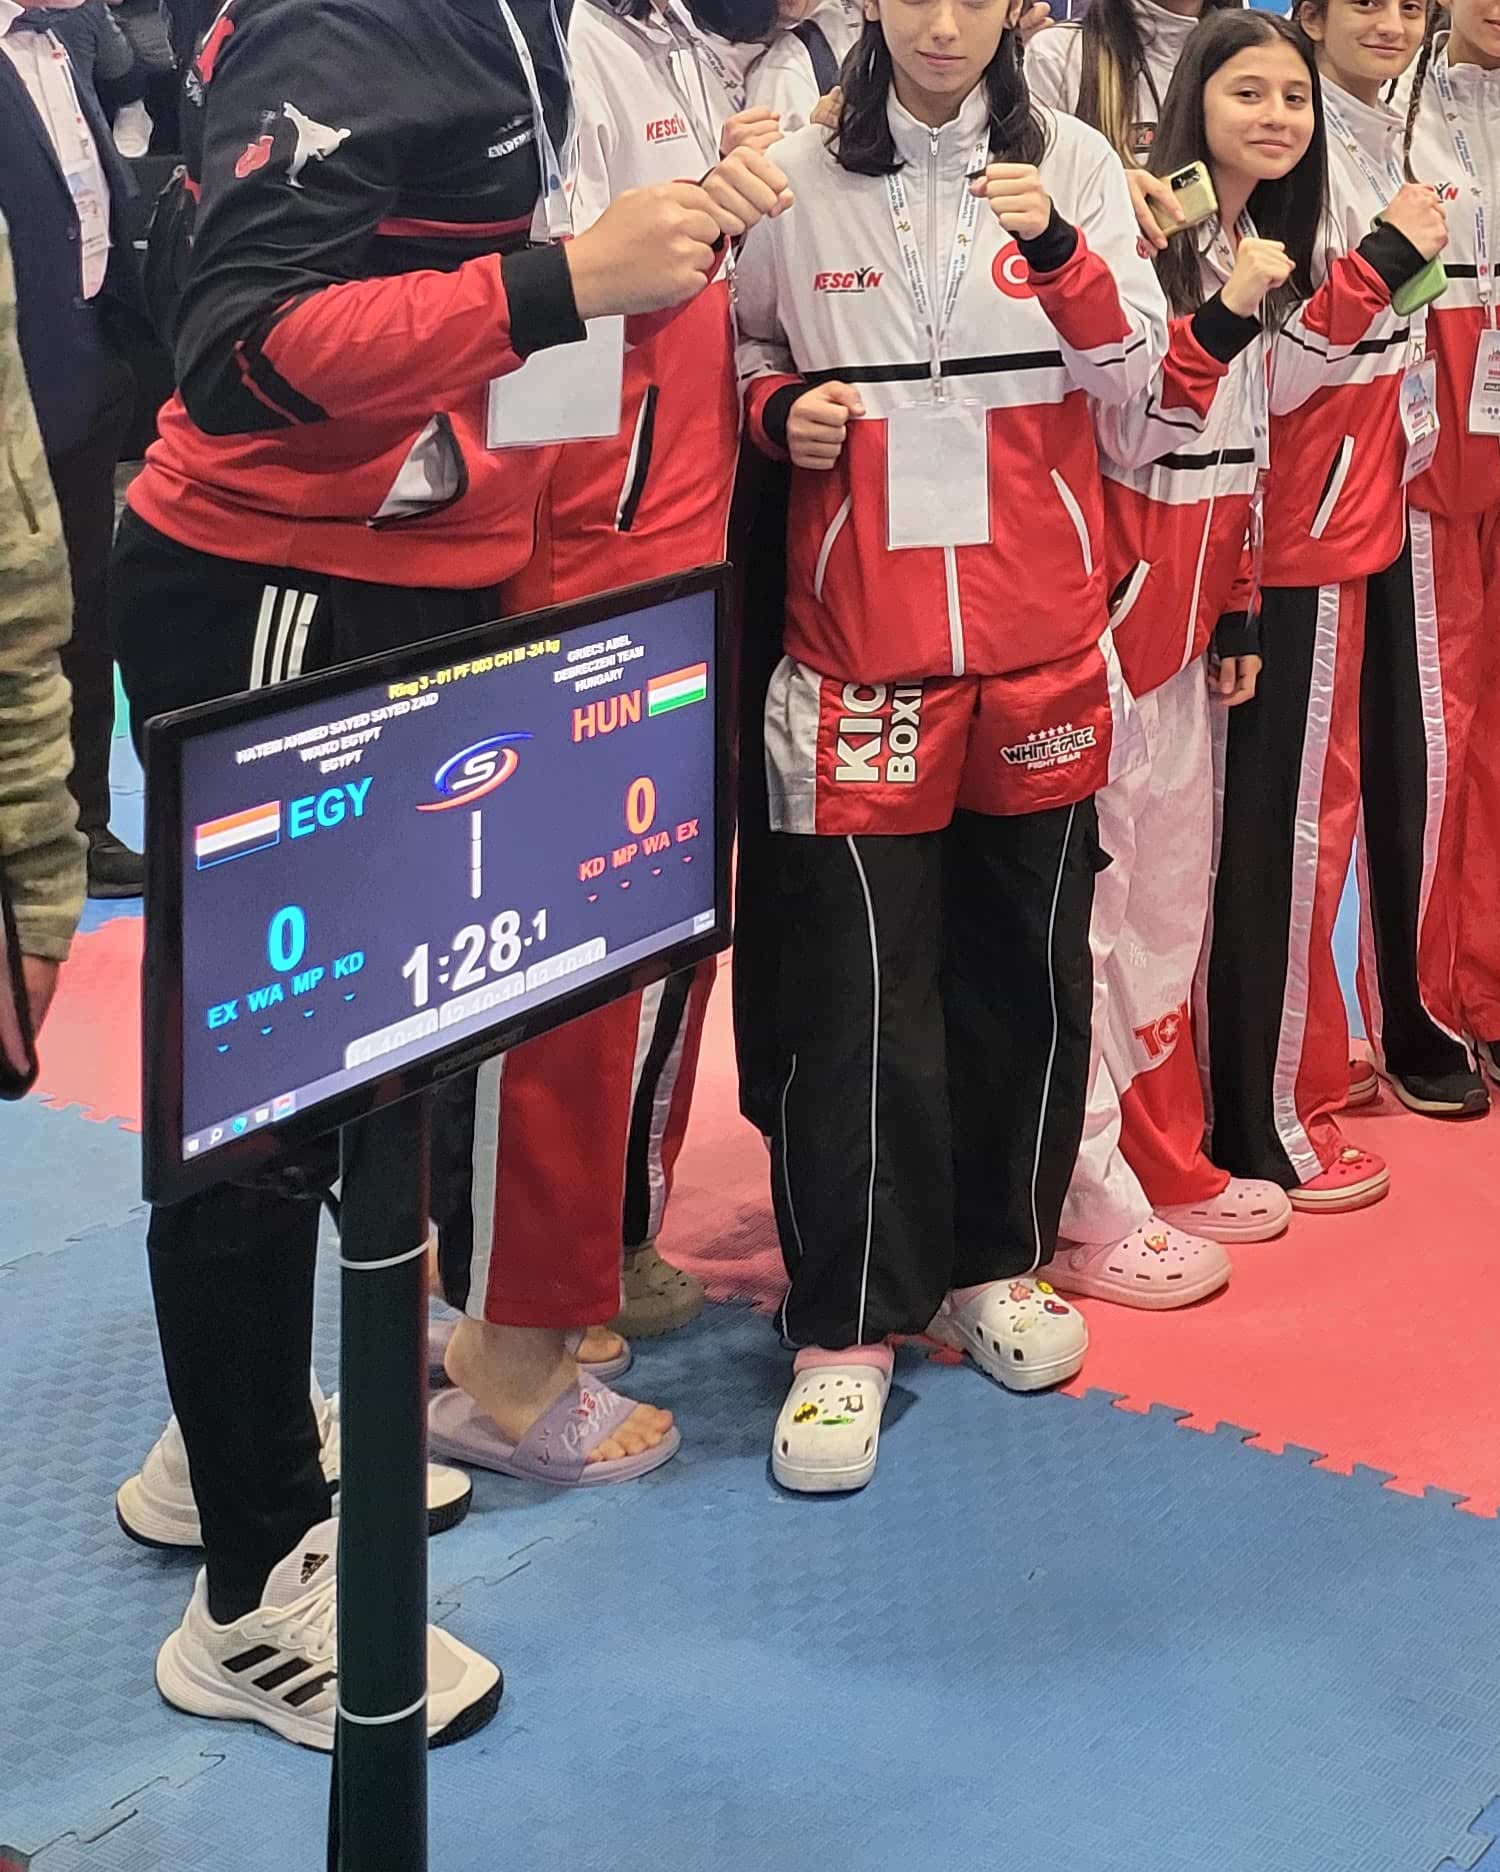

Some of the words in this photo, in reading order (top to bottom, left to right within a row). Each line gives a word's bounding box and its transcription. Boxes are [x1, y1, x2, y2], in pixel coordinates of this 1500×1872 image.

[388, 683, 420, 700] Ring
[420, 676, 429, 690] 3
[572, 689, 642, 743] HUN
[289, 777, 373, 839] EGY
[626, 776, 656, 834] 0
[579, 856, 605, 882] KD
[612, 843, 638, 868] MP
[642, 831, 671, 856] WA
[675, 818, 699, 843] EX
[268, 905, 306, 972] 0
[208, 999, 239, 1030] EX
[247, 984, 284, 1013] WA
[291, 967, 325, 996] MP
[332, 951, 365, 979] KD
